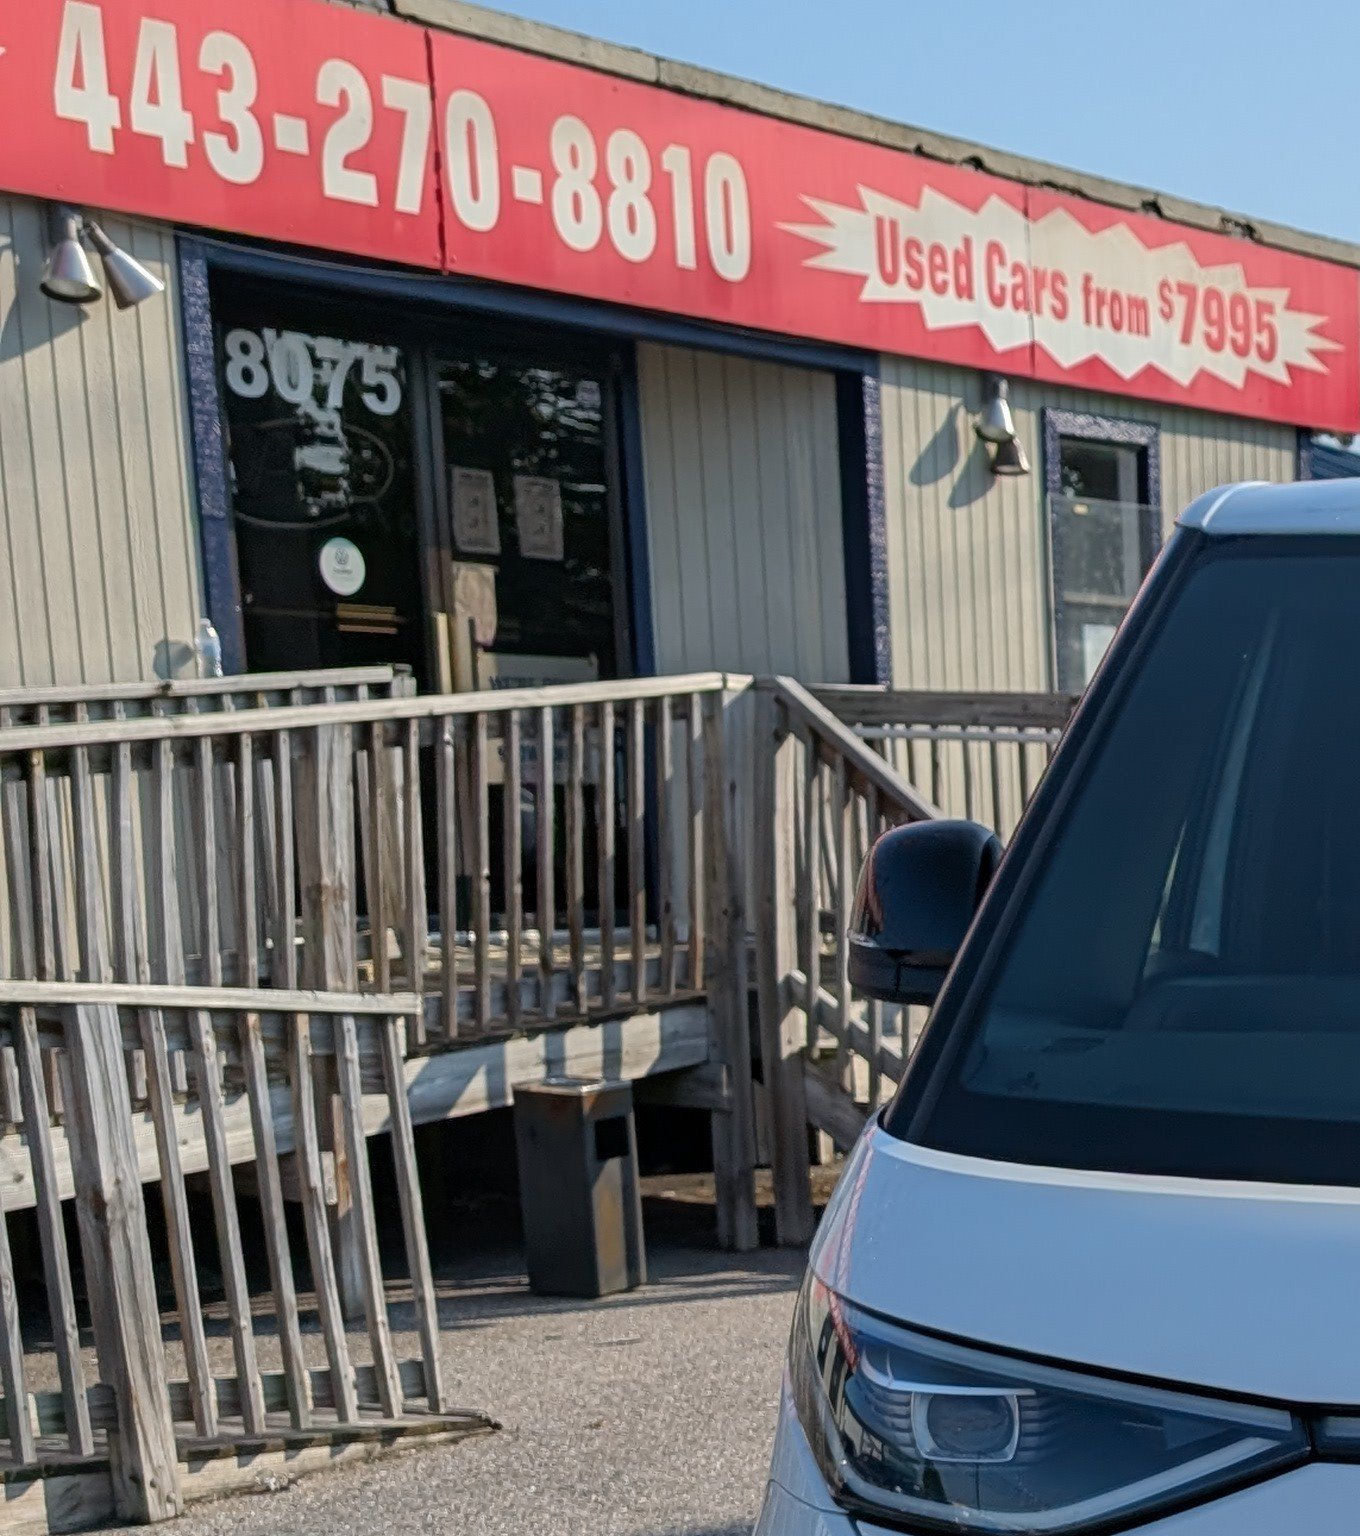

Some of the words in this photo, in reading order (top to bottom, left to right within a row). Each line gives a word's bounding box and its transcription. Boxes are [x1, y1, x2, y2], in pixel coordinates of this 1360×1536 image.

[53, 0, 751, 283] 443-270-8810
[874, 214, 974, 300] Used
[985, 240, 1067, 320] Cars
[1081, 276, 1150, 338] from
[1159, 276, 1279, 363] $7995
[225, 328, 401, 416] 8075
